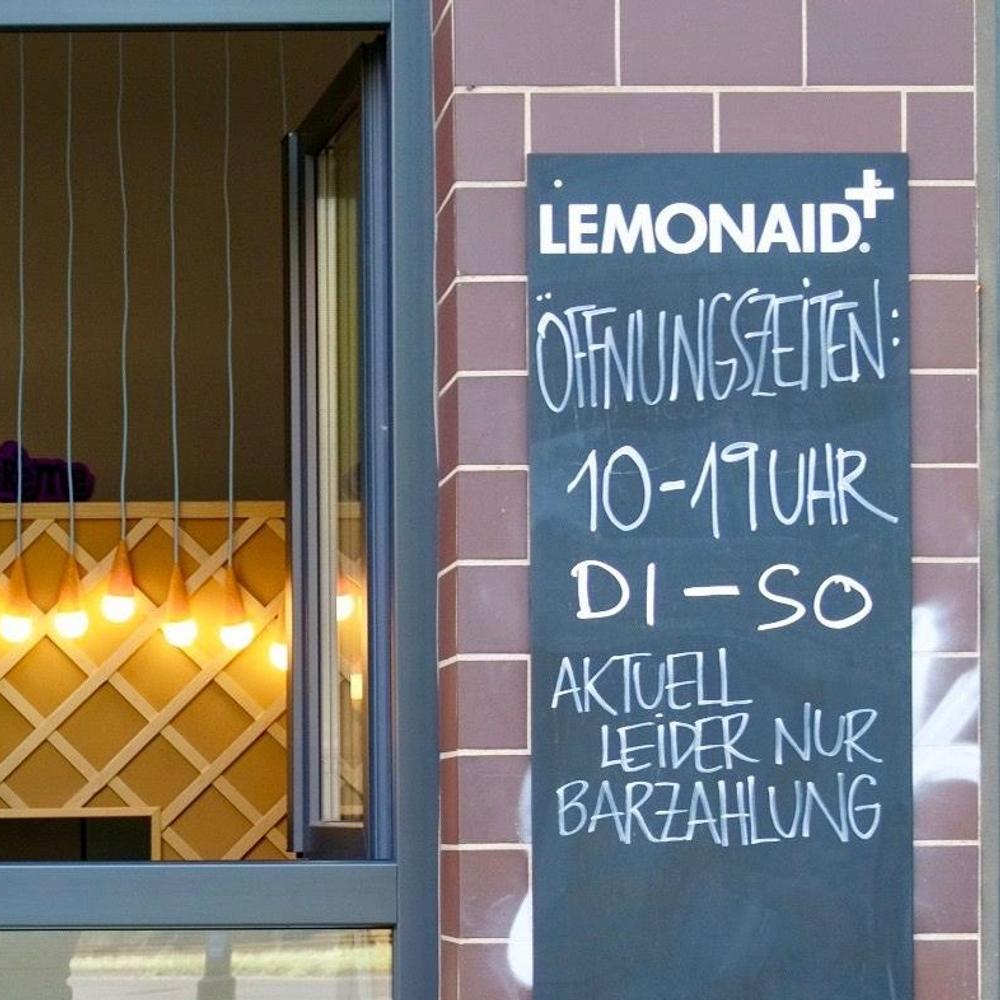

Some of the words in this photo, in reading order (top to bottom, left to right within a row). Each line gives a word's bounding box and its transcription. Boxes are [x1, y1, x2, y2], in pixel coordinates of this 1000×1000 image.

[768, 442, 899, 526] UHR
[570, 559, 656, 627] DI
[757, 563, 873, 631] SO
[550, 648, 753, 716] AKTUELL
[600, 713, 760, 773] LEIDER
[774, 702, 883, 766] NUR
[555, 772, 882, 847] BARZAHLUNG
